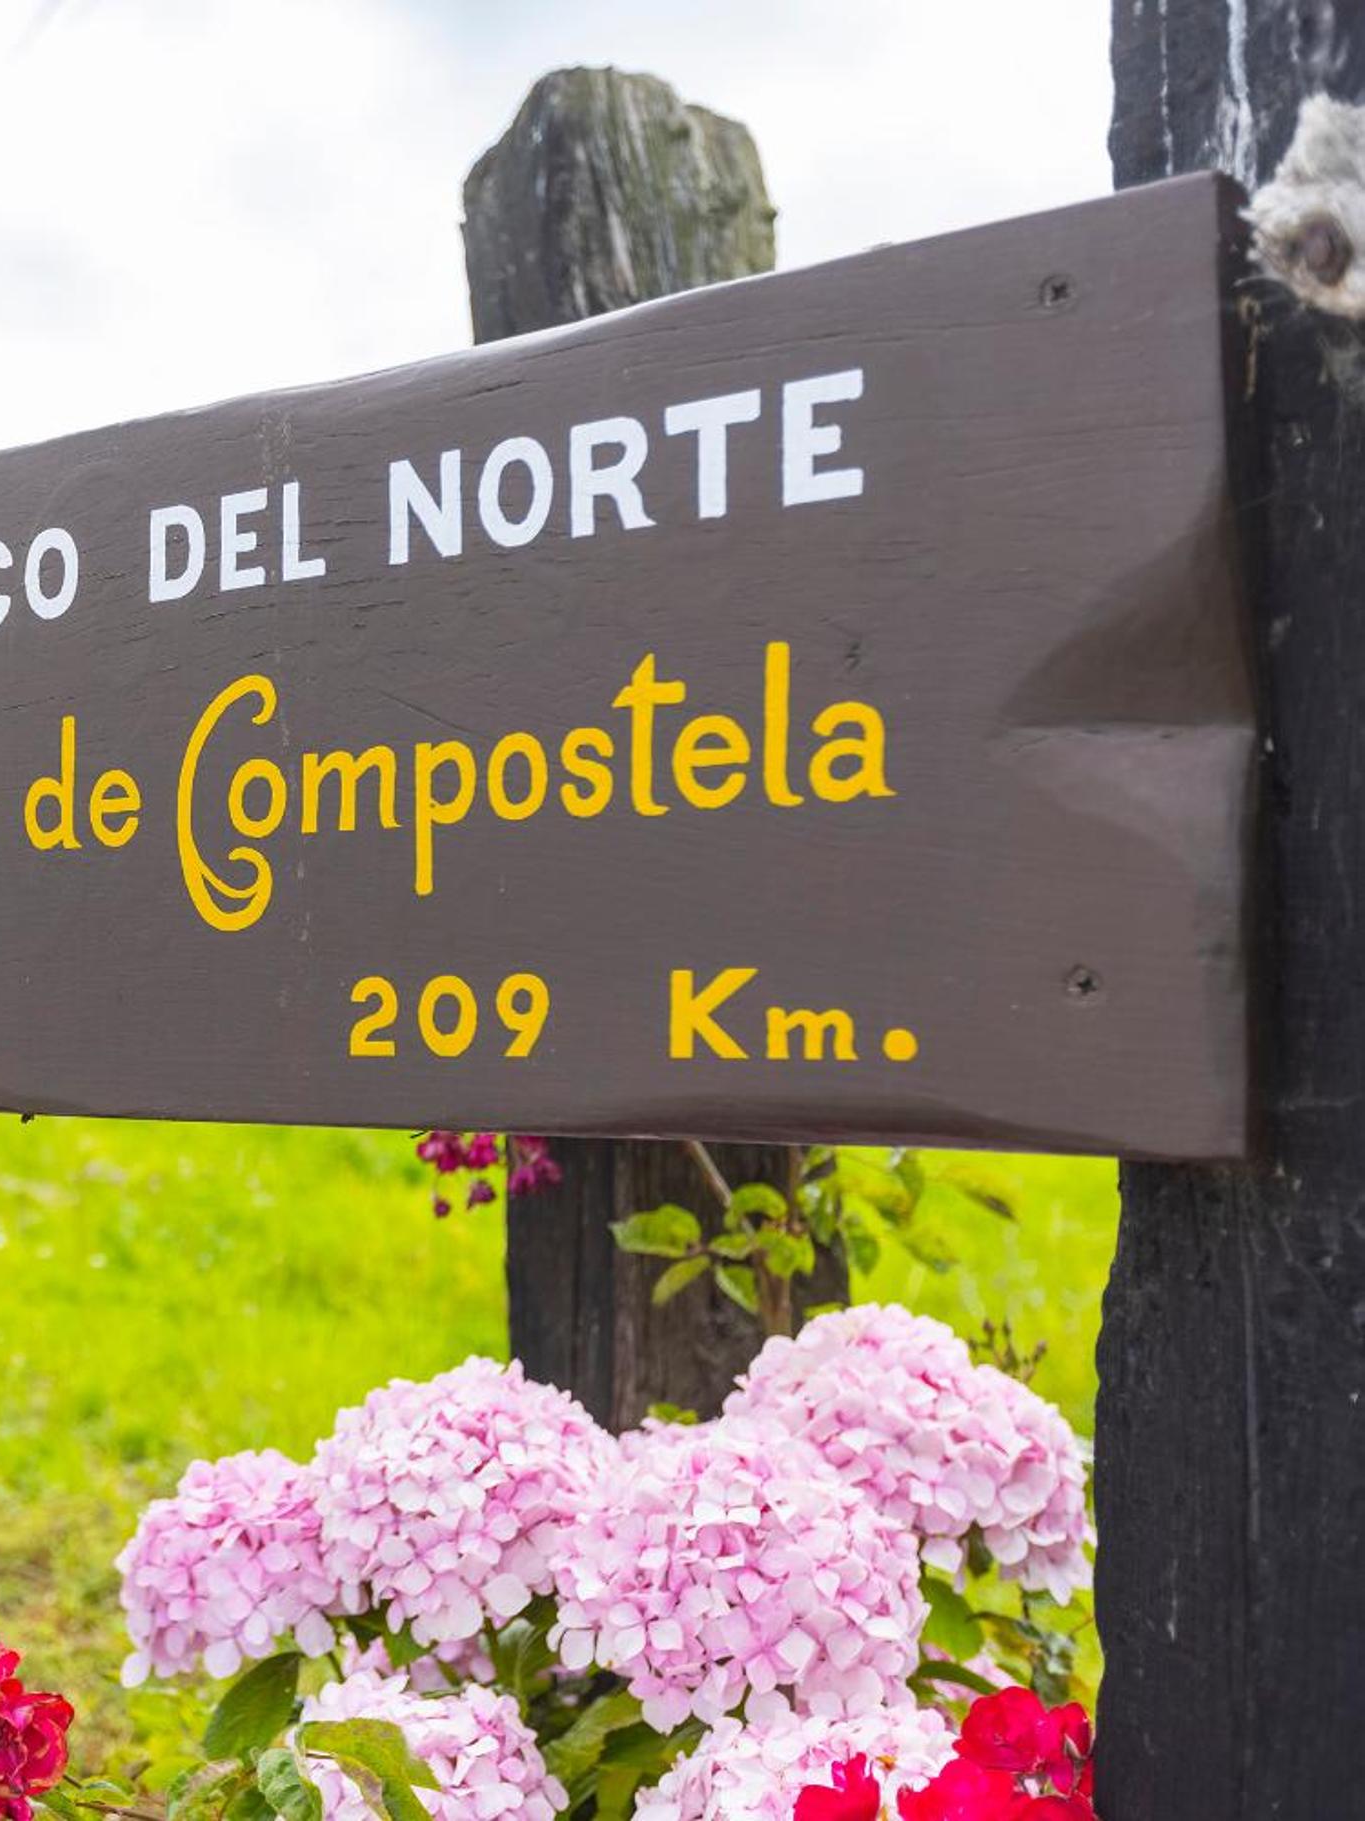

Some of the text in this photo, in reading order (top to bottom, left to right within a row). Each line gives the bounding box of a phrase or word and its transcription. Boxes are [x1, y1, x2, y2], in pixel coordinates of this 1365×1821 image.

[148, 479, 327, 604] DEL
[387, 367, 865, 566] NORTE
[23, 715, 142, 851] de
[176, 640, 896, 932] Compostela
[348, 967, 920, 1062] 209 Km.
